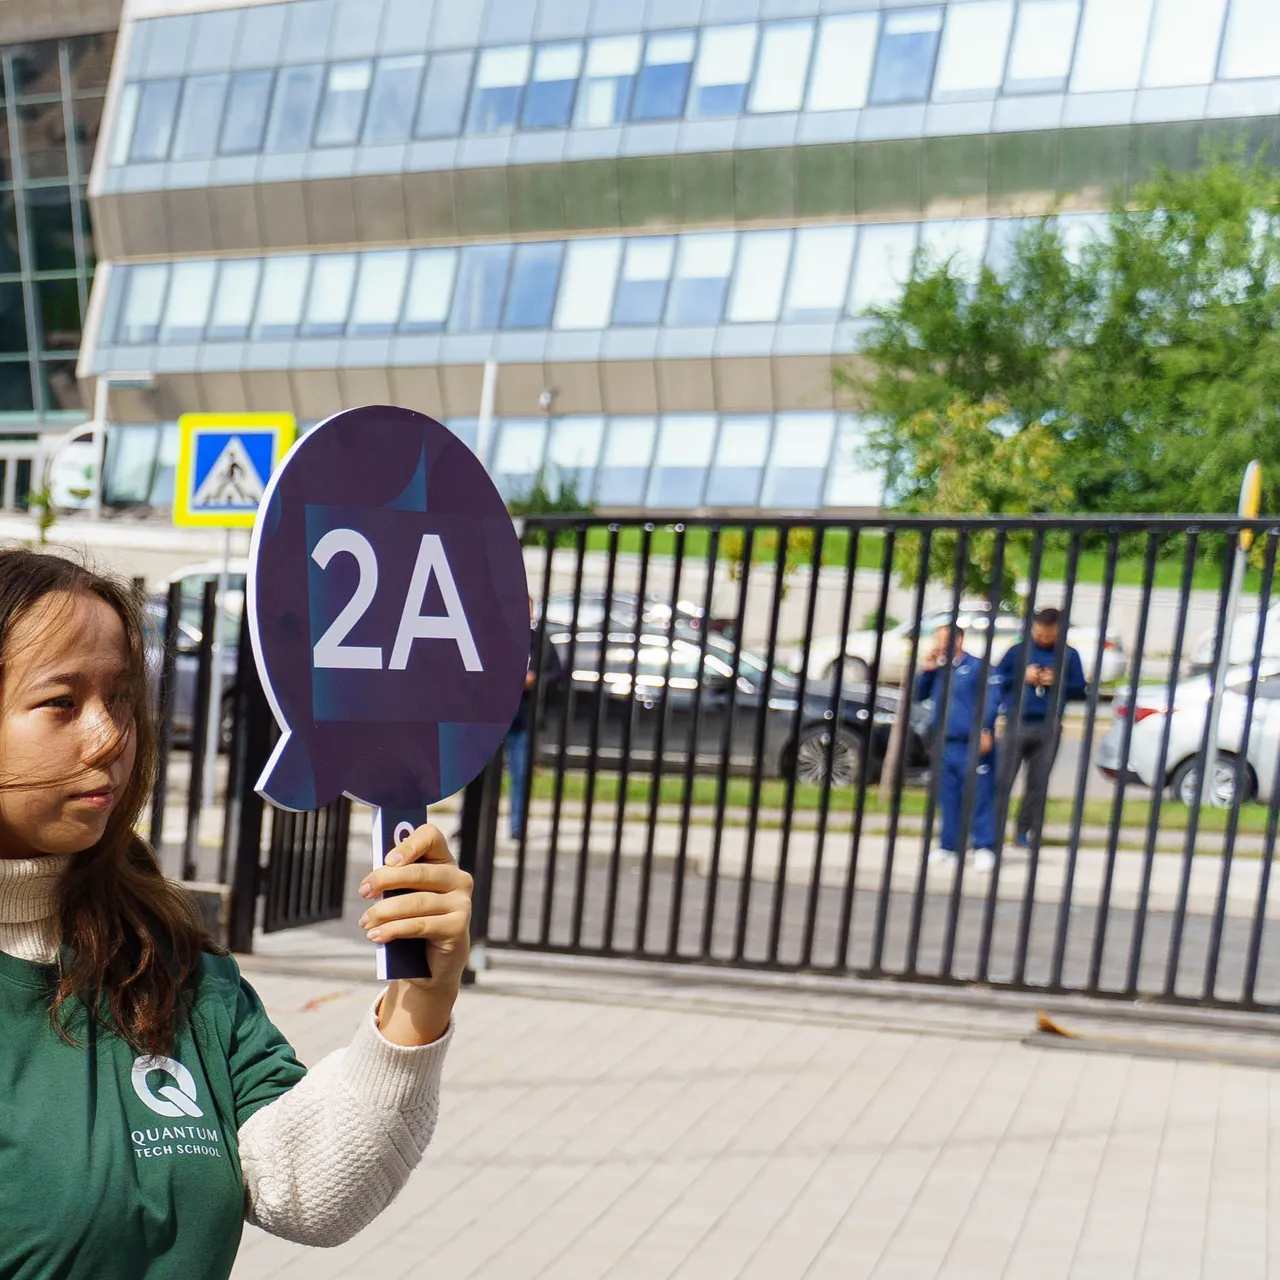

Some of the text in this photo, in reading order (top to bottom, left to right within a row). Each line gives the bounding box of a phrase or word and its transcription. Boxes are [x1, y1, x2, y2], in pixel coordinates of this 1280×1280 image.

[310, 528, 484, 672] 2A
[131, 1054, 204, 1118] Q
[131, 1126, 219, 1146] QUANTUM
[134, 1143, 222, 1158] TECH SCHOOL
